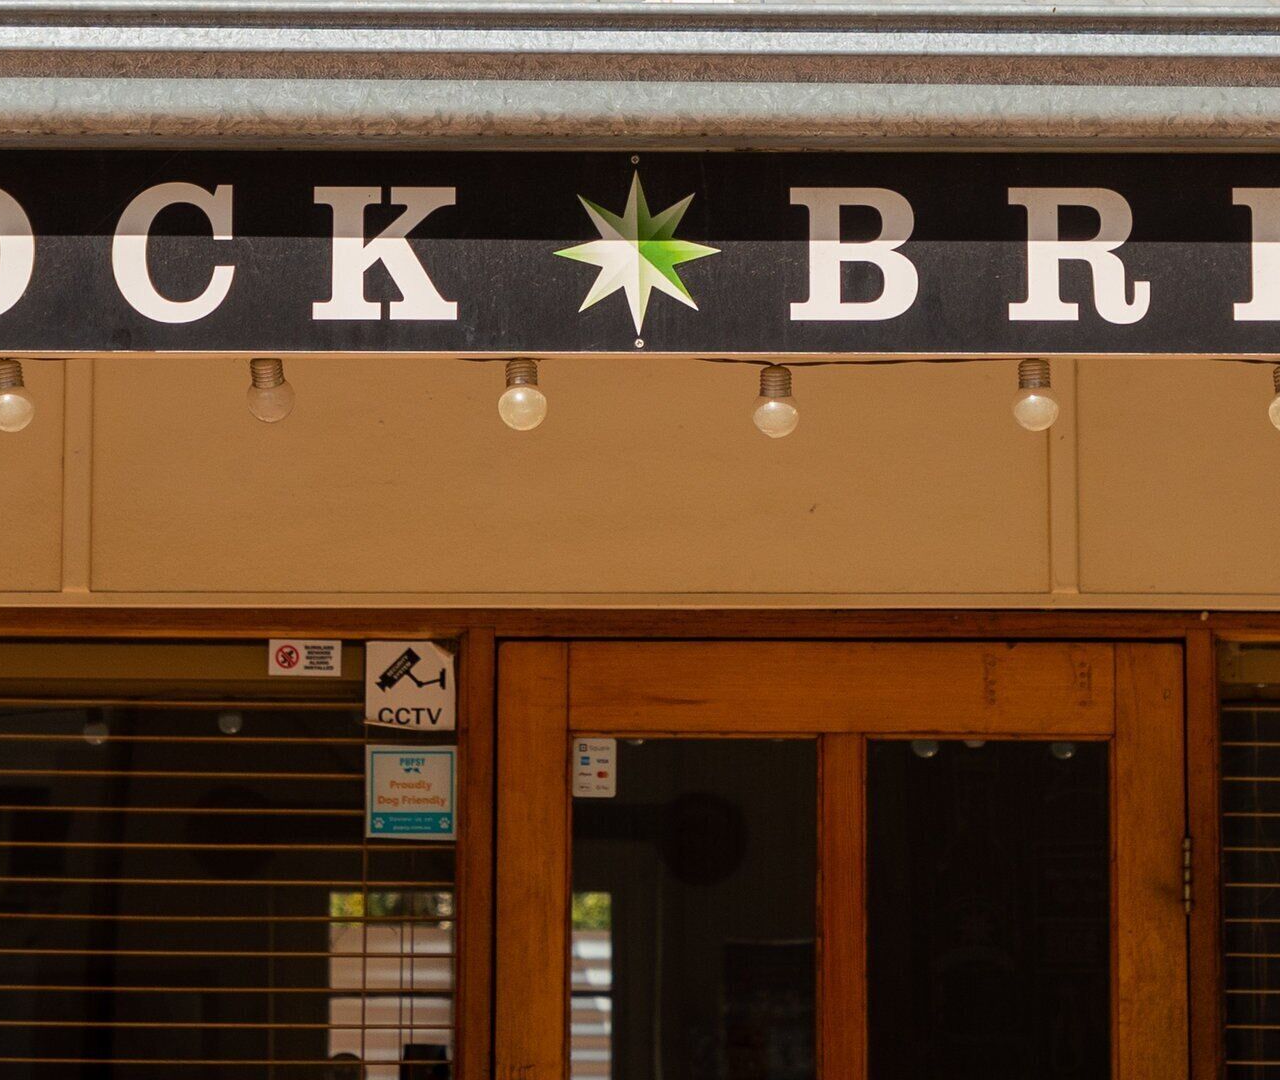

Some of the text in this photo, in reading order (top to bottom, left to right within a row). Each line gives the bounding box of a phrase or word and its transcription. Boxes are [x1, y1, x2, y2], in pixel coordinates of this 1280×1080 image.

[378, 707, 442, 725] CCTV
[389, 780, 432, 791] Proudly
[377, 795, 447, 807] Dog Friendly
